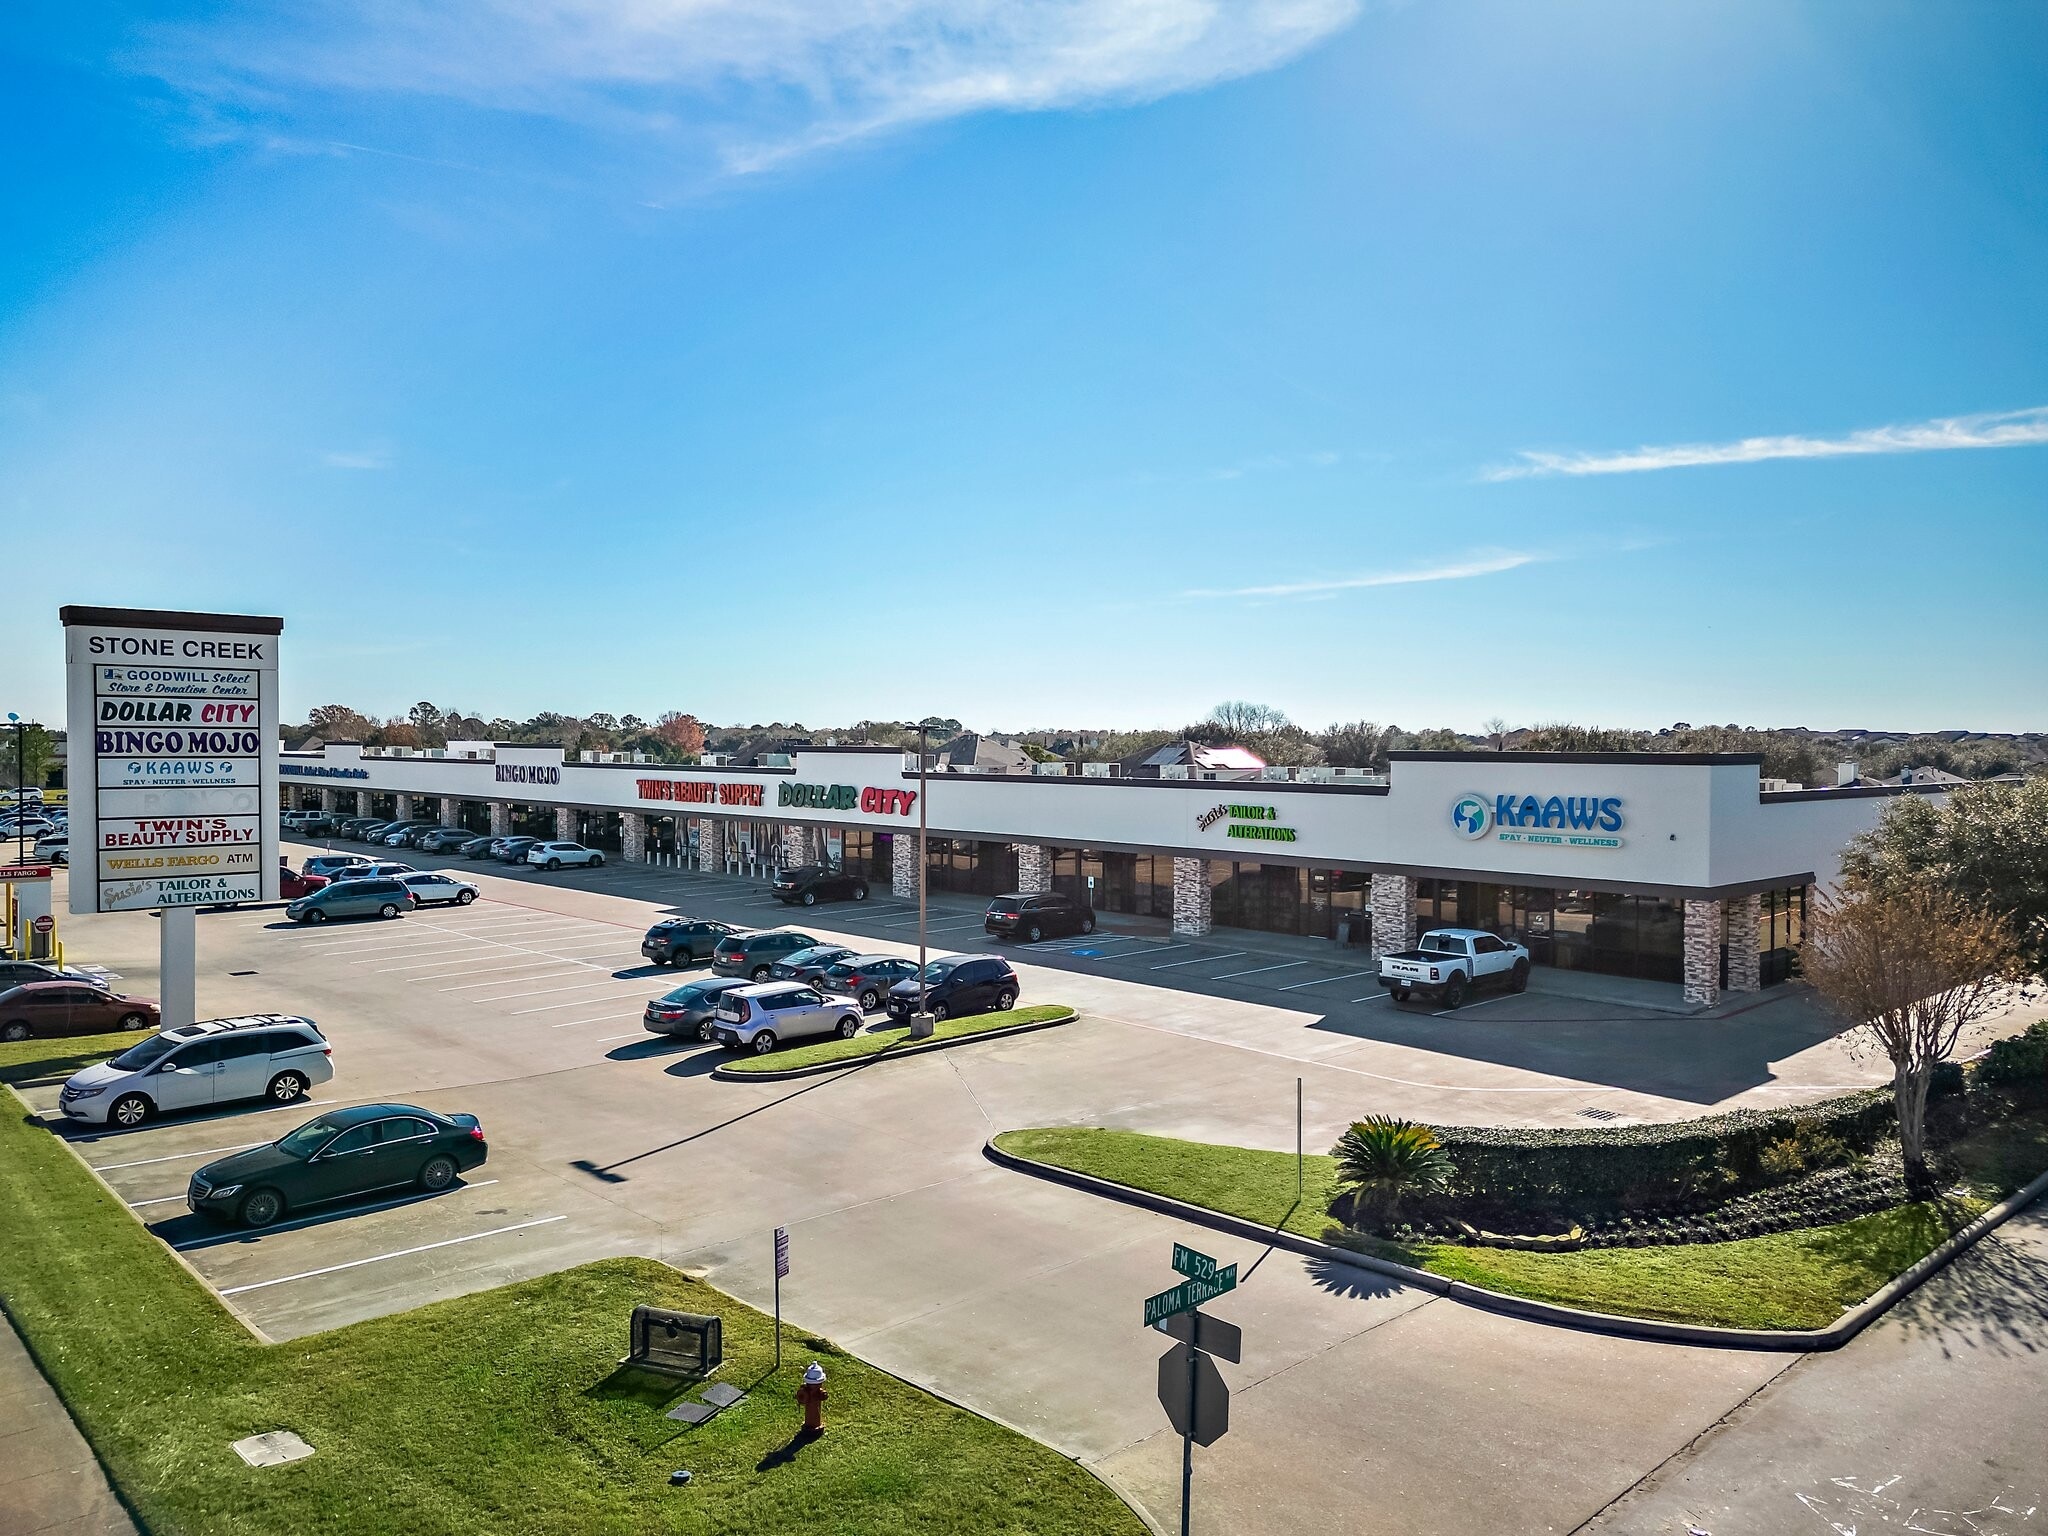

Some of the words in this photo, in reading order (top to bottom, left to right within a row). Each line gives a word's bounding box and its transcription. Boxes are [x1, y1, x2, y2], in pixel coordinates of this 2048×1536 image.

[89, 636, 174, 656] STONE
[182, 640, 264, 660] CREEK
[127, 670, 209, 682] GOODWILL
[212, 673, 250, 683] Select
[108, 682, 141, 692] Store
[145, 683, 153, 692] &
[155, 683, 207, 694] Donation
[212, 684, 248, 695] Center
[100, 701, 192, 722] DOLLAR
[201, 704, 255, 723] CITY
[97, 730, 184, 753] BINGO
[188, 731, 260, 753] MOJO
[146, 761, 215, 775] KAAWS
[495, 764, 528, 782] BINGO
[528, 766, 560, 785] MOJO
[636, 779, 671, 800] TWIN'S
[673, 782, 716, 803] BEAUTY
[719, 784, 764, 806] SUPPLY
[778, 783, 857, 810] DOLLAR
[861, 786, 917, 816] CITY
[1227, 804, 1265, 819] TAILOR
[1267, 806, 1276, 820] &
[1496, 794, 1623, 832] KAAWS
[135, 818, 227, 831] TWIN'S
[1227, 824, 1296, 842] ALTERATIONS
[105, 831, 179, 846] BEAUTY
[185, 828, 253, 843] SUPPLY
[1499, 833, 1521, 841] SPAY
[1528, 835, 1562, 844] NEUTER
[1569, 837, 1618, 847] WELLNESS
[107, 857, 164, 869] WELLS
[166, 854, 220, 867] FARGO
[226, 853, 253, 864] ATM
[156, 878, 211, 891] TAILOR
[217, 877, 228, 888] &
[156, 888, 255, 904] ALTERATIONS
[1392, 964, 1419, 973] RAM
[1173, 1247, 1188, 1270] FM
[1194, 1255, 1215, 1280] 529
[1145, 1289, 1181, 1322] PALOMA
[1225, 1267, 1236, 1279] WAY
